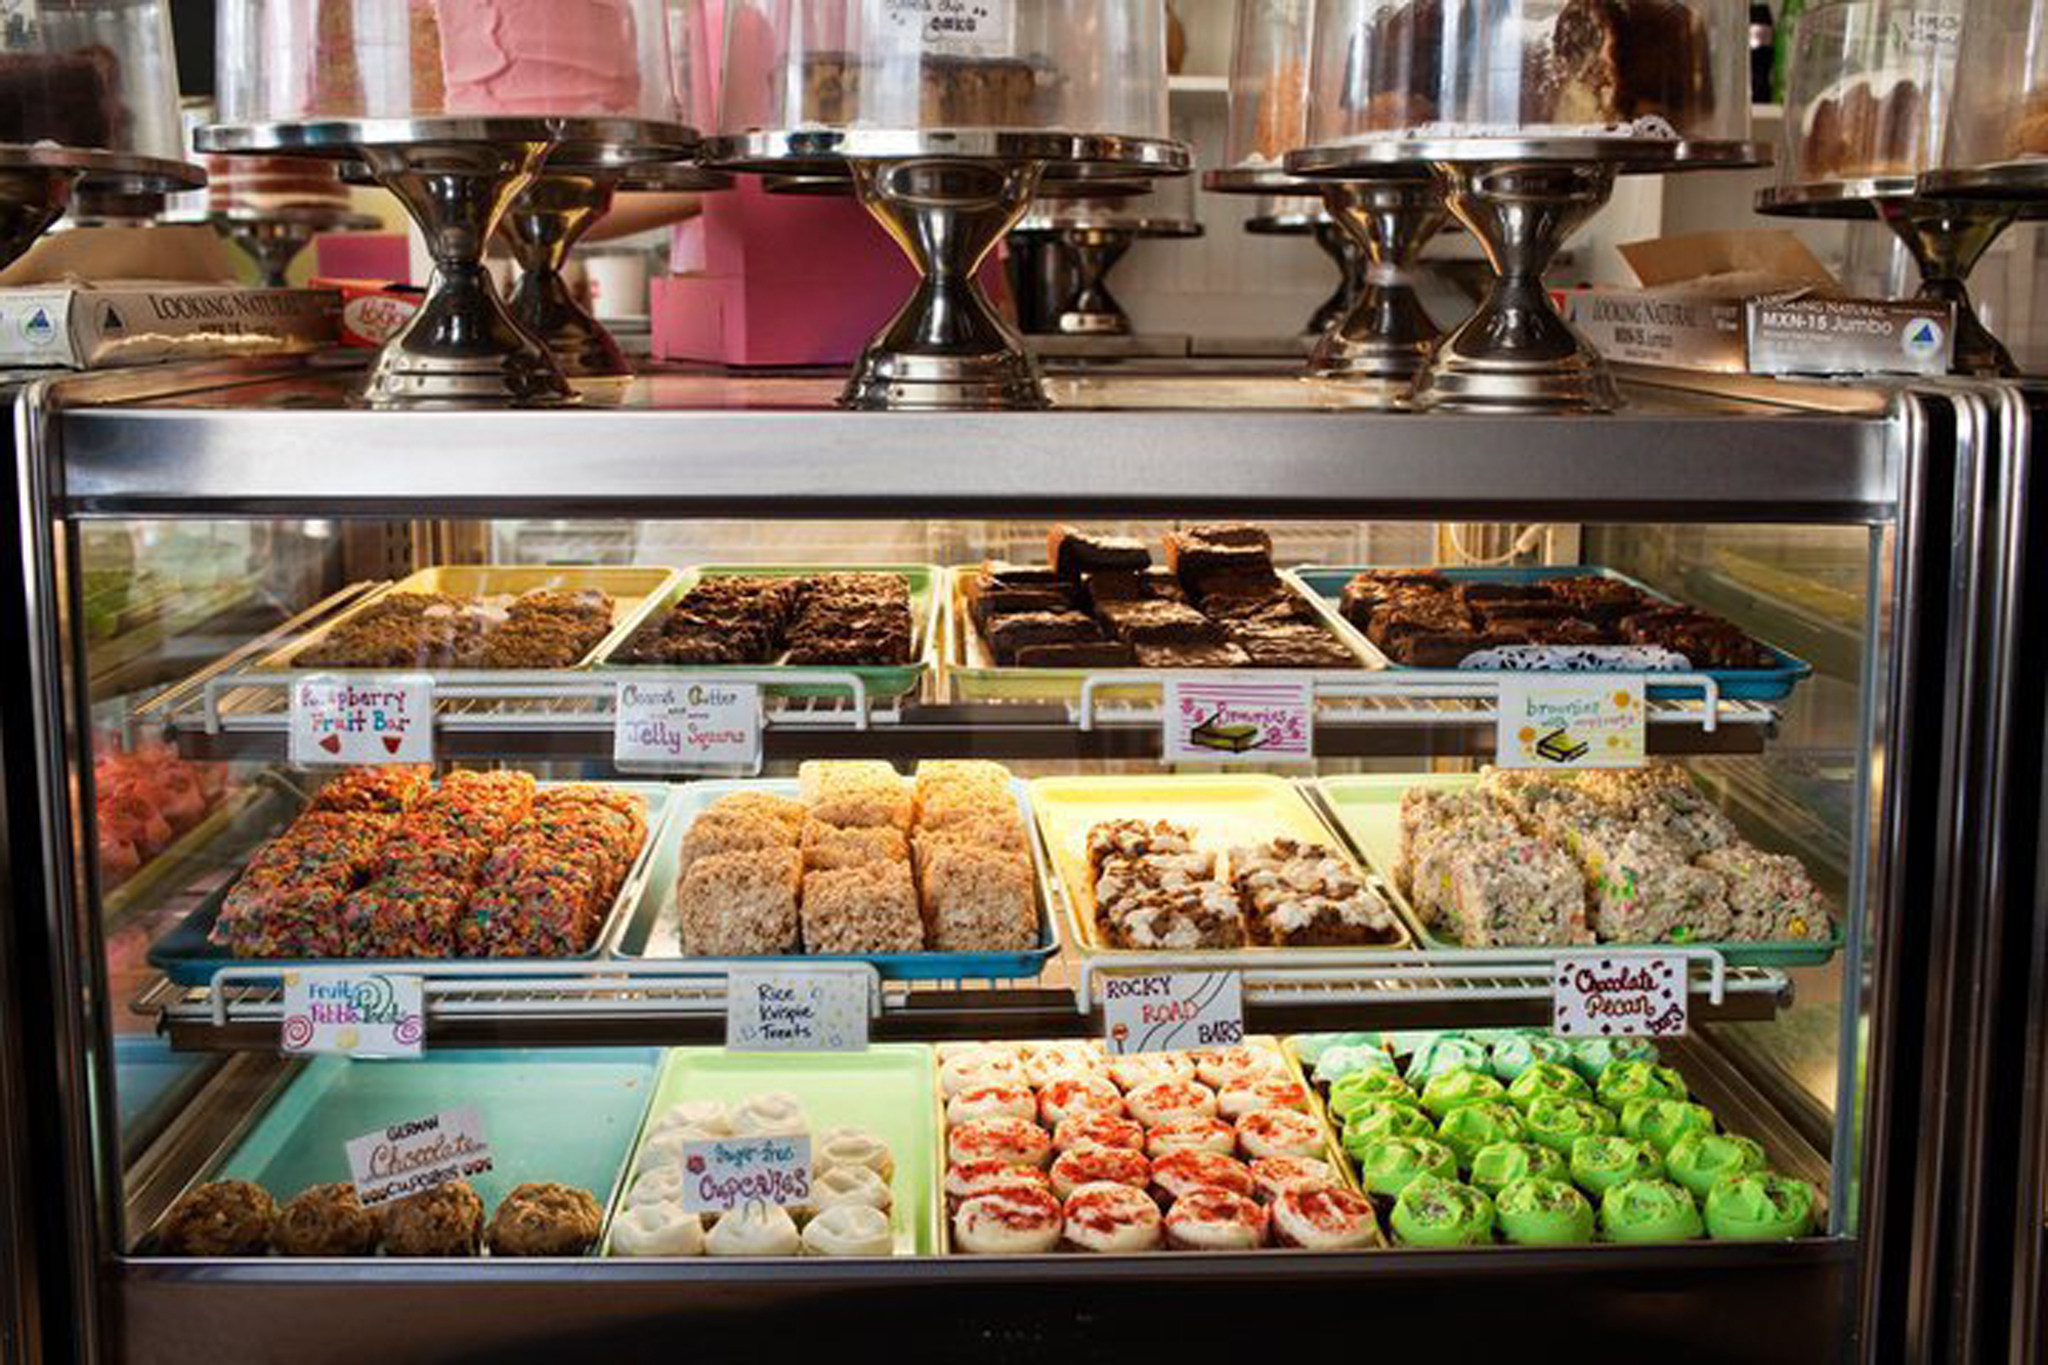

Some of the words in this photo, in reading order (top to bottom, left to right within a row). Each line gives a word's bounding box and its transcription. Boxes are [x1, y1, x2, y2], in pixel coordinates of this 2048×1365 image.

[148, 294, 233, 320] LOOKING
[1825, 302, 1887, 317] NATURAL
[1830, 315, 1894, 336] Jumbo
[1527, 697, 1599, 717] brownies
[311, 709, 367, 732] Fruit
[373, 709, 411, 732] Bar
[625, 720, 681, 755] Jelly
[757, 983, 796, 1001] Rice
[1106, 975, 1172, 999] ROCKY
[1575, 966, 1660, 995] Chocolate
[309, 981, 364, 1008] Fruity
[1585, 994, 1656, 1019] Pecan
[1142, 1000, 1199, 1024] ROAD
[759, 1024, 812, 1040] Treats
[1198, 1020, 1242, 1044] BARS
[386, 1115, 439, 1142] GERMAN
[362, 1132, 486, 1181] Chocolate
